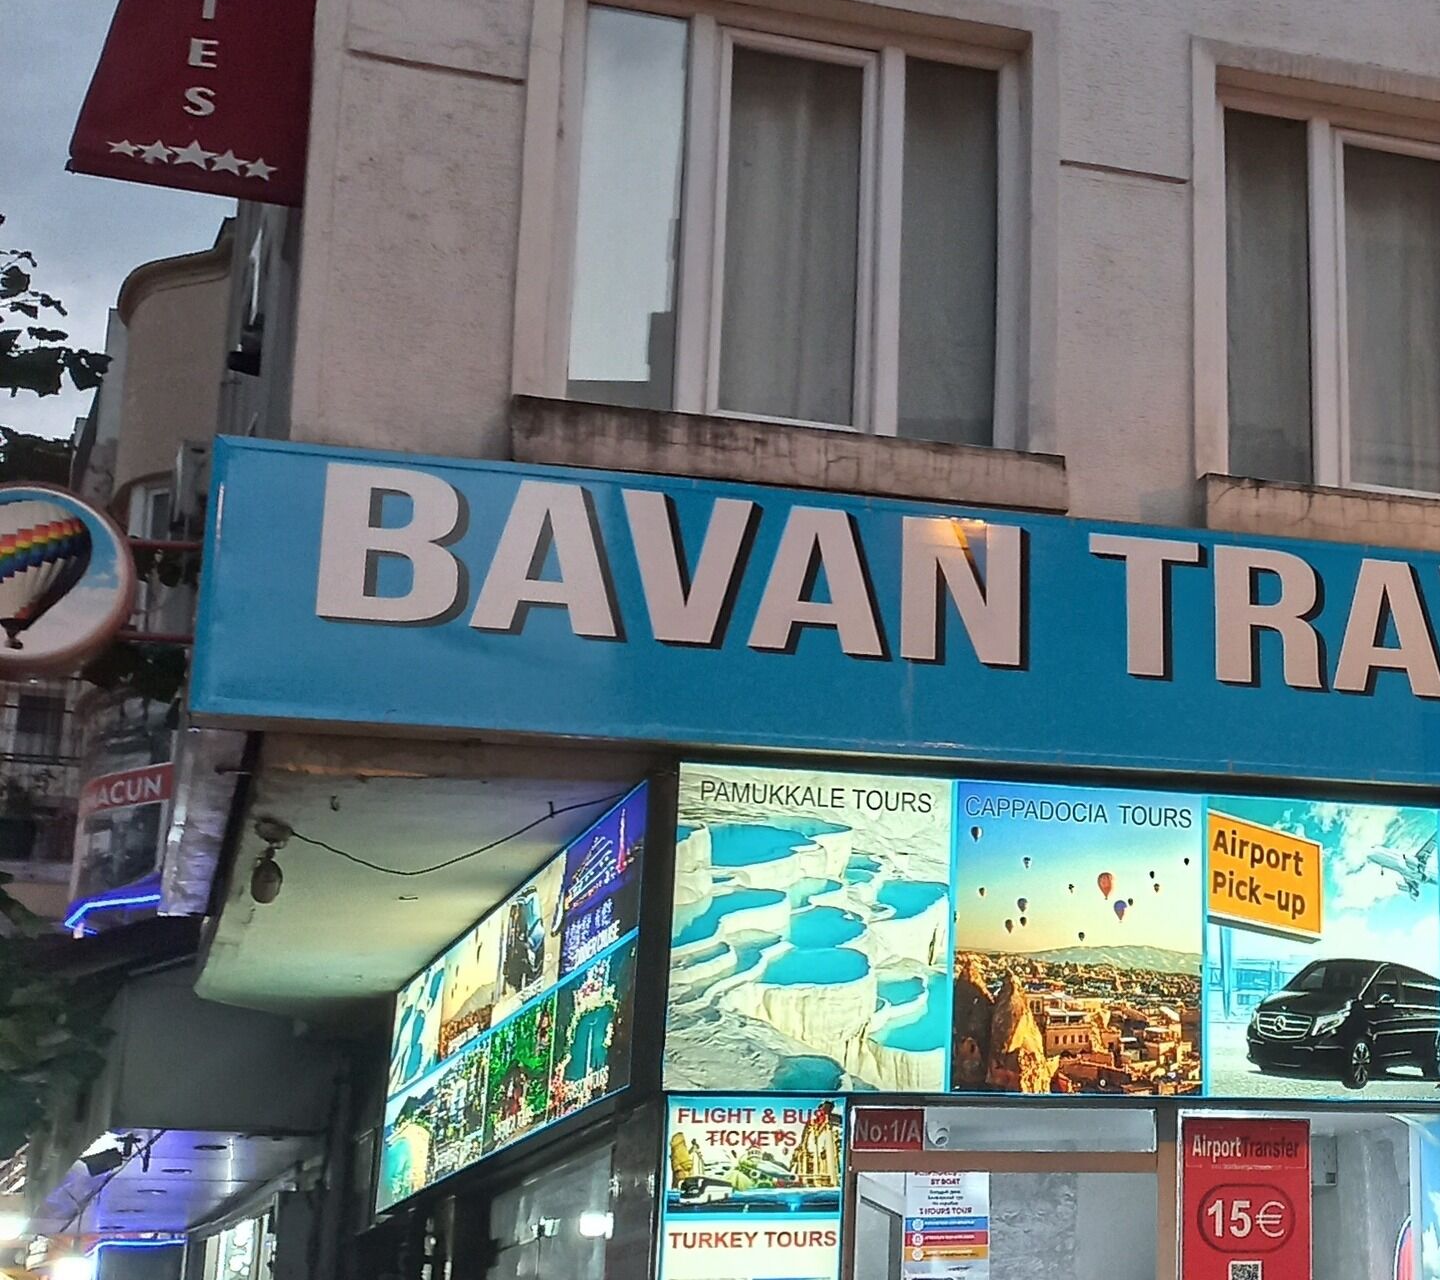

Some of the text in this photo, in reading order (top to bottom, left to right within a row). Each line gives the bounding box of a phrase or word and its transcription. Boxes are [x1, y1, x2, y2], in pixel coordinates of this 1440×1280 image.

[315, 461, 1025, 668] BAVAN
[699, 779, 932, 814] PAMUKKALE TOURS
[965, 795, 1193, 829] CAPPADOCIA TOURS
[1212, 829, 1304, 877] Airport
[1212, 870, 1306, 921] Pick-up
[677, 1107, 827, 1125] FLIGHT & BUS
[705, 1130, 798, 1147] TICKETS
[668, 1230, 838, 1249] TURKEY TOURS
